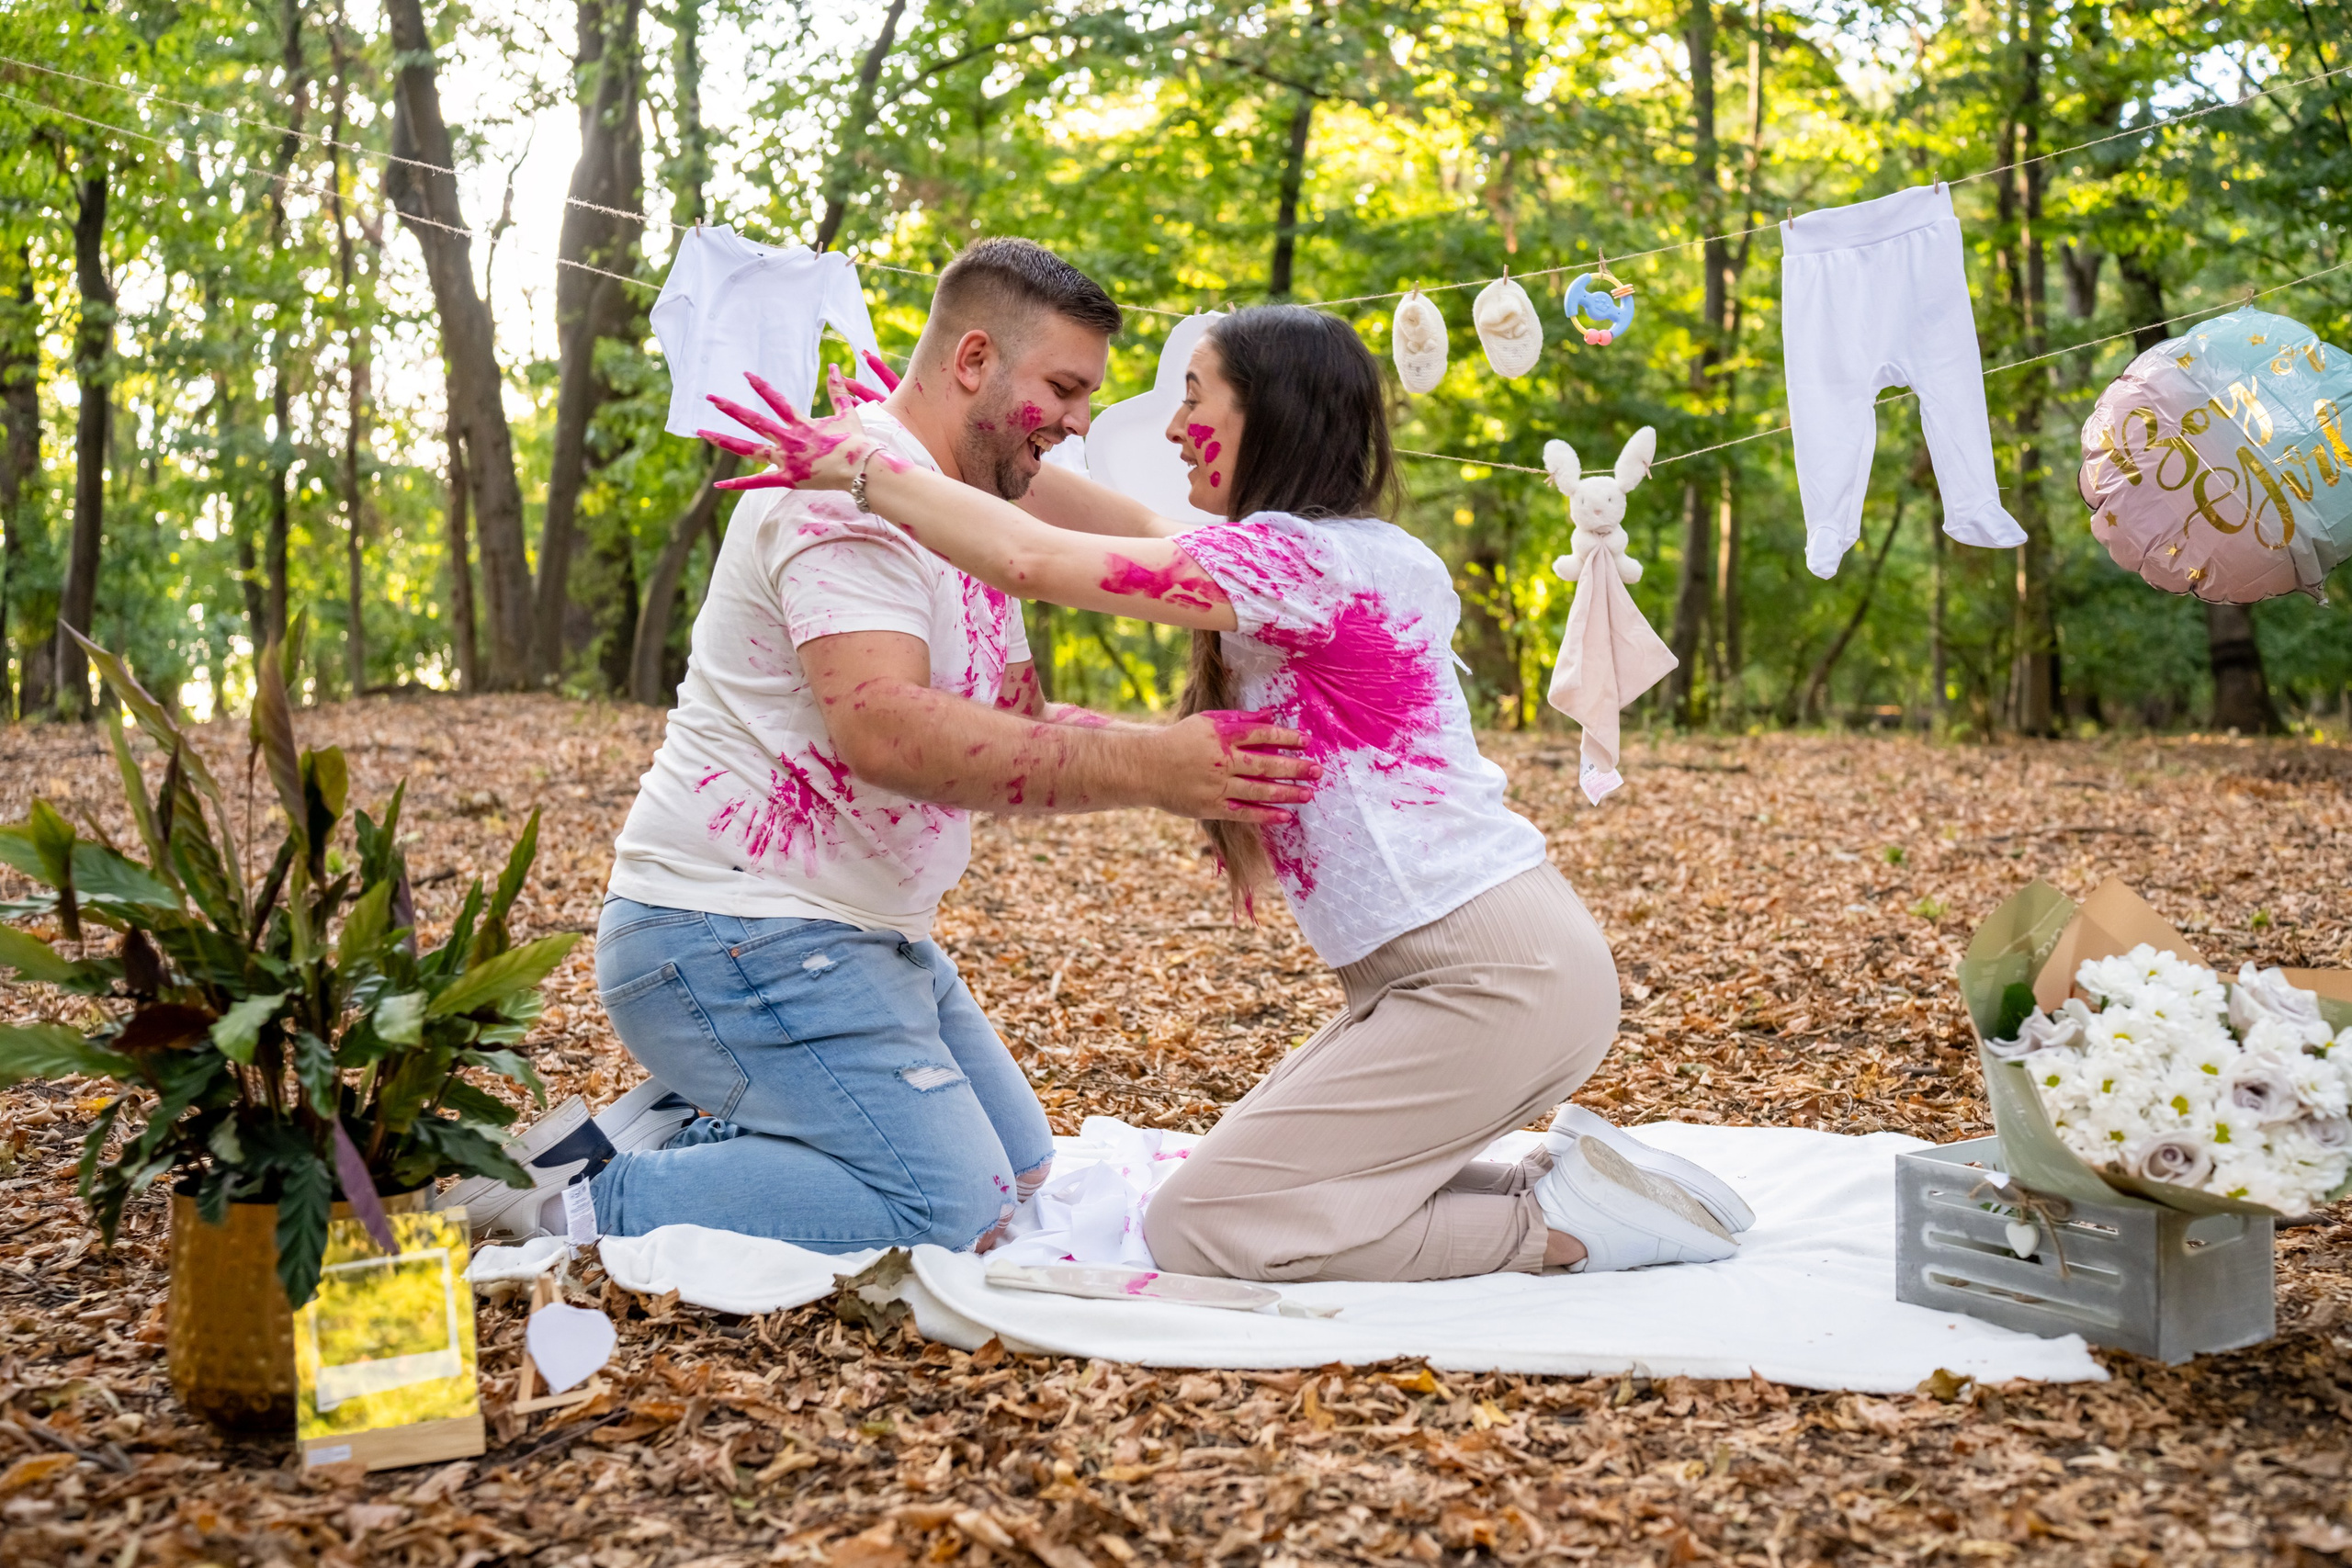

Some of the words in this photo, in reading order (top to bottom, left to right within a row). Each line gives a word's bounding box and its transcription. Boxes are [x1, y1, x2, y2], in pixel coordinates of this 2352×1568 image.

[2093, 375, 2274, 491] Boy
[2270, 344, 2326, 376] or
[2183, 398, 2352, 550] Girl
